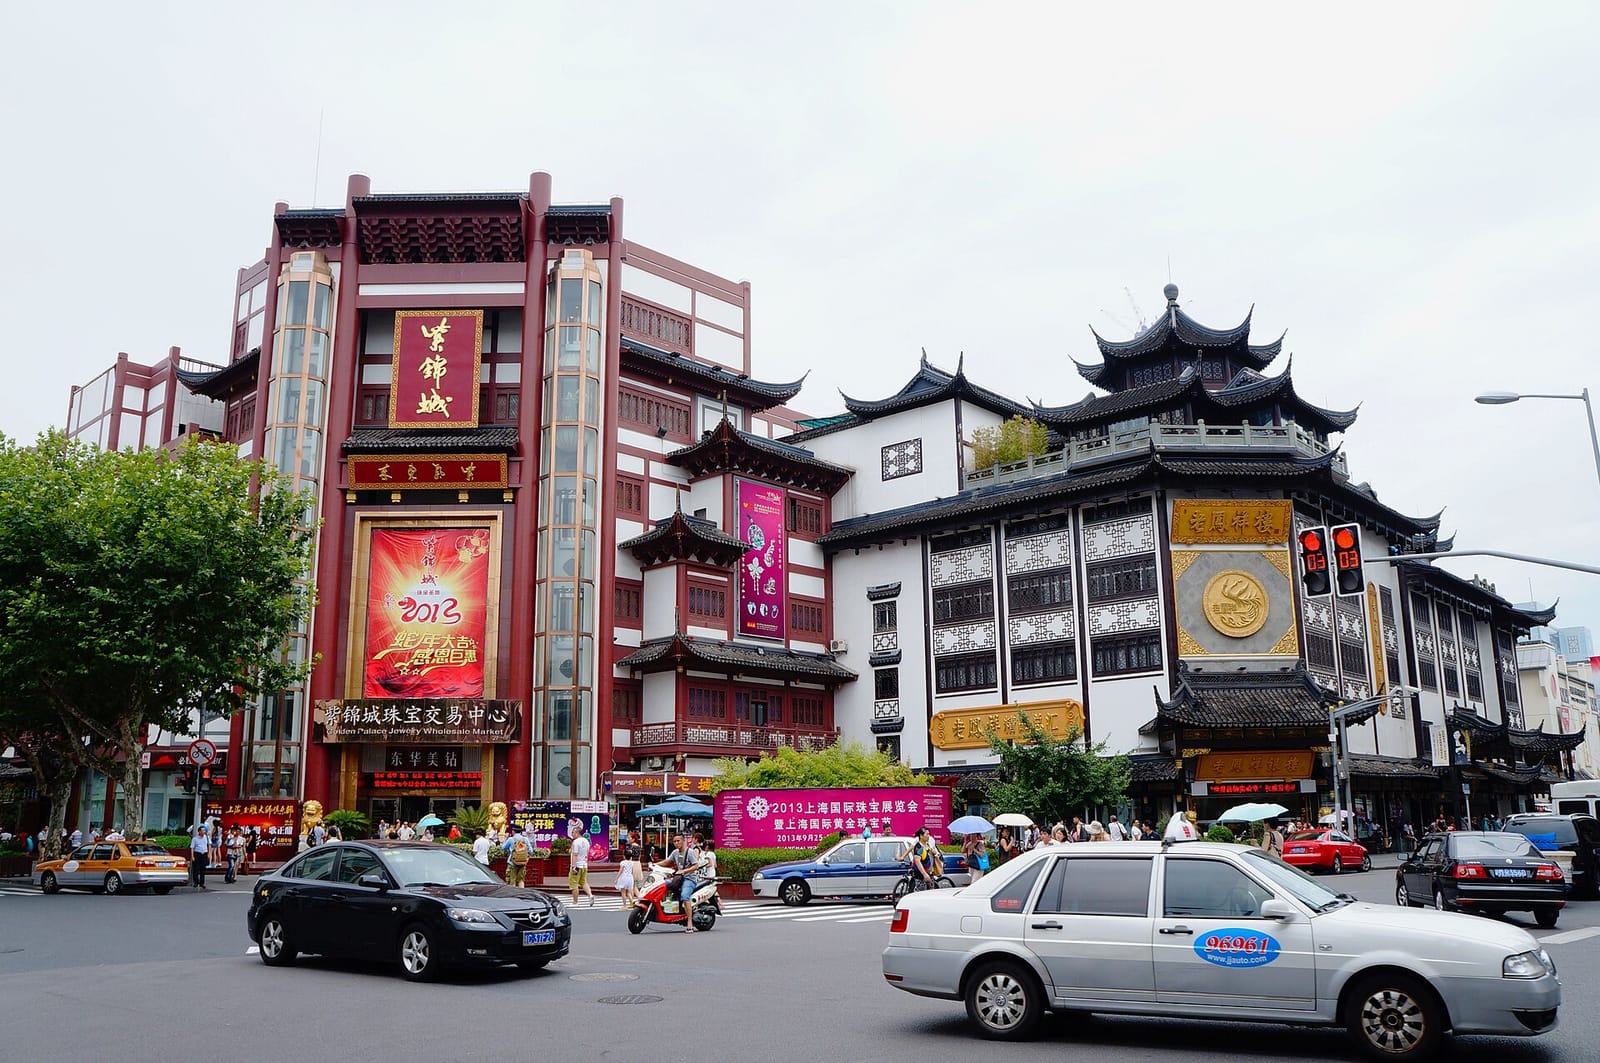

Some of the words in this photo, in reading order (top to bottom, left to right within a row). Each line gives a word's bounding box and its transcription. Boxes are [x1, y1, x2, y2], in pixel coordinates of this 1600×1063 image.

[1306, 553, 1327, 571] 03
[1338, 550, 1359, 569] 03
[398, 596, 463, 625] 2013
[388, 631, 470, 650] 蛇年大吉
[409, 648, 477, 666] 感恩巨惠
[324, 704, 508, 726] 紫锦城珠宝交易中心
[358, 727, 387, 736] Palace
[424, 726, 471, 736] Wholesale
[472, 727, 504, 736] Market
[391, 751, 457, 767] 东华美钻
[771, 799, 919, 814] 2013上海国际珠宝展览会
[773, 816, 893, 831] 暨上海国际黄金珠宝节
[776, 833, 824, 843] 2013年9月25
[1204, 936, 1269, 954] 96961
[1206, 953, 1267, 965] www.jjauto.com
